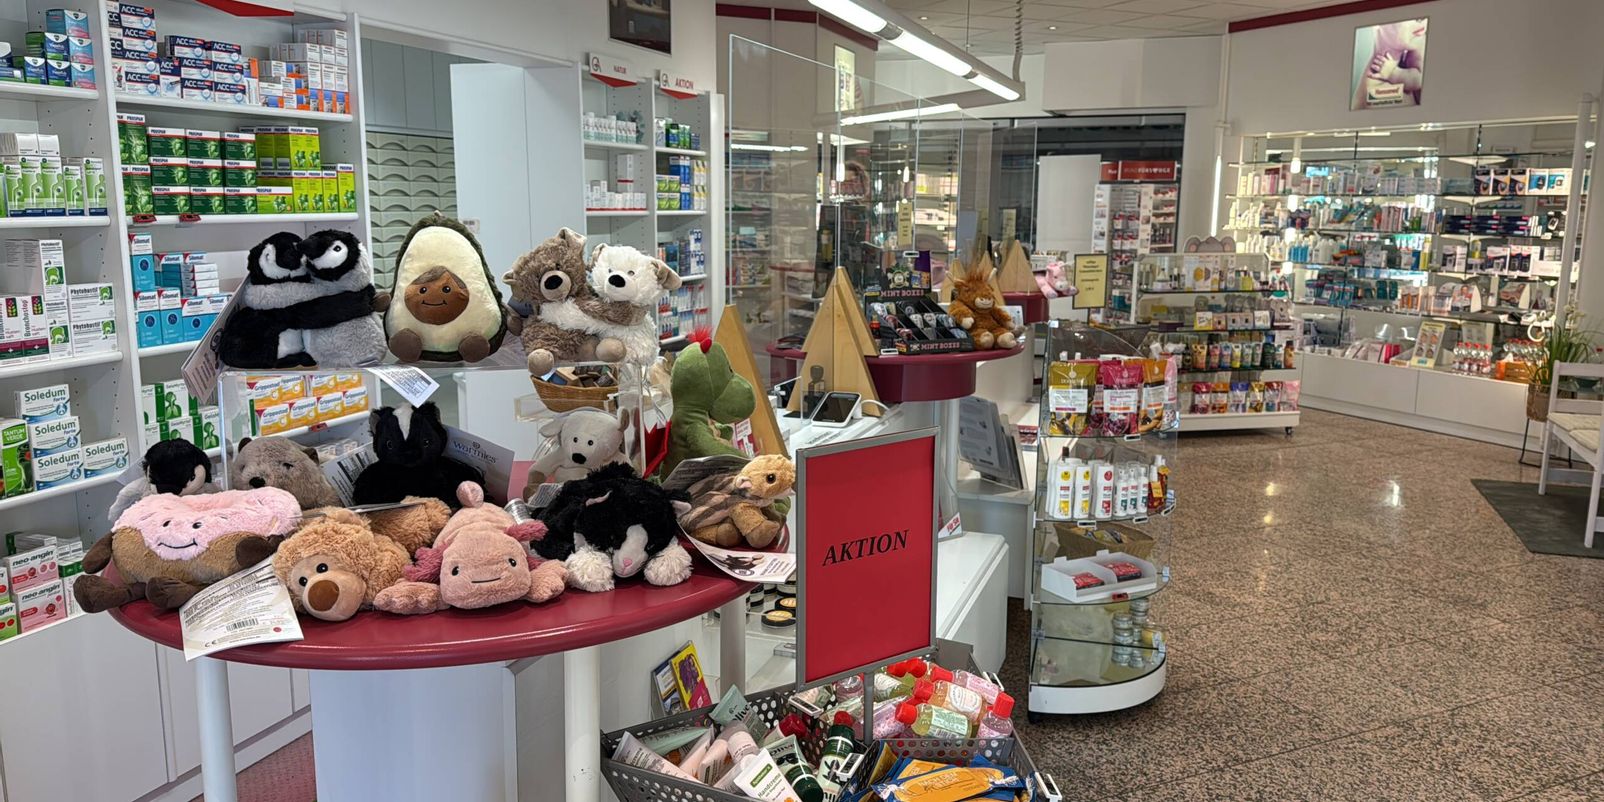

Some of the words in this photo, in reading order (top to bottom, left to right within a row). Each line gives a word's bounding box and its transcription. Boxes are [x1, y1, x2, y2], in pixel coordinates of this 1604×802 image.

[121, 6, 136, 14] ACC
[124, 28, 139, 37] ACC
[24, 388, 66, 402] Soledum
[35, 420, 76, 435] Soledum
[85, 442, 125, 457] Soledum
[38, 452, 79, 468] Soledum
[822, 529, 910, 566] AKTION
[758, 773, 781, 798] Handcreme
